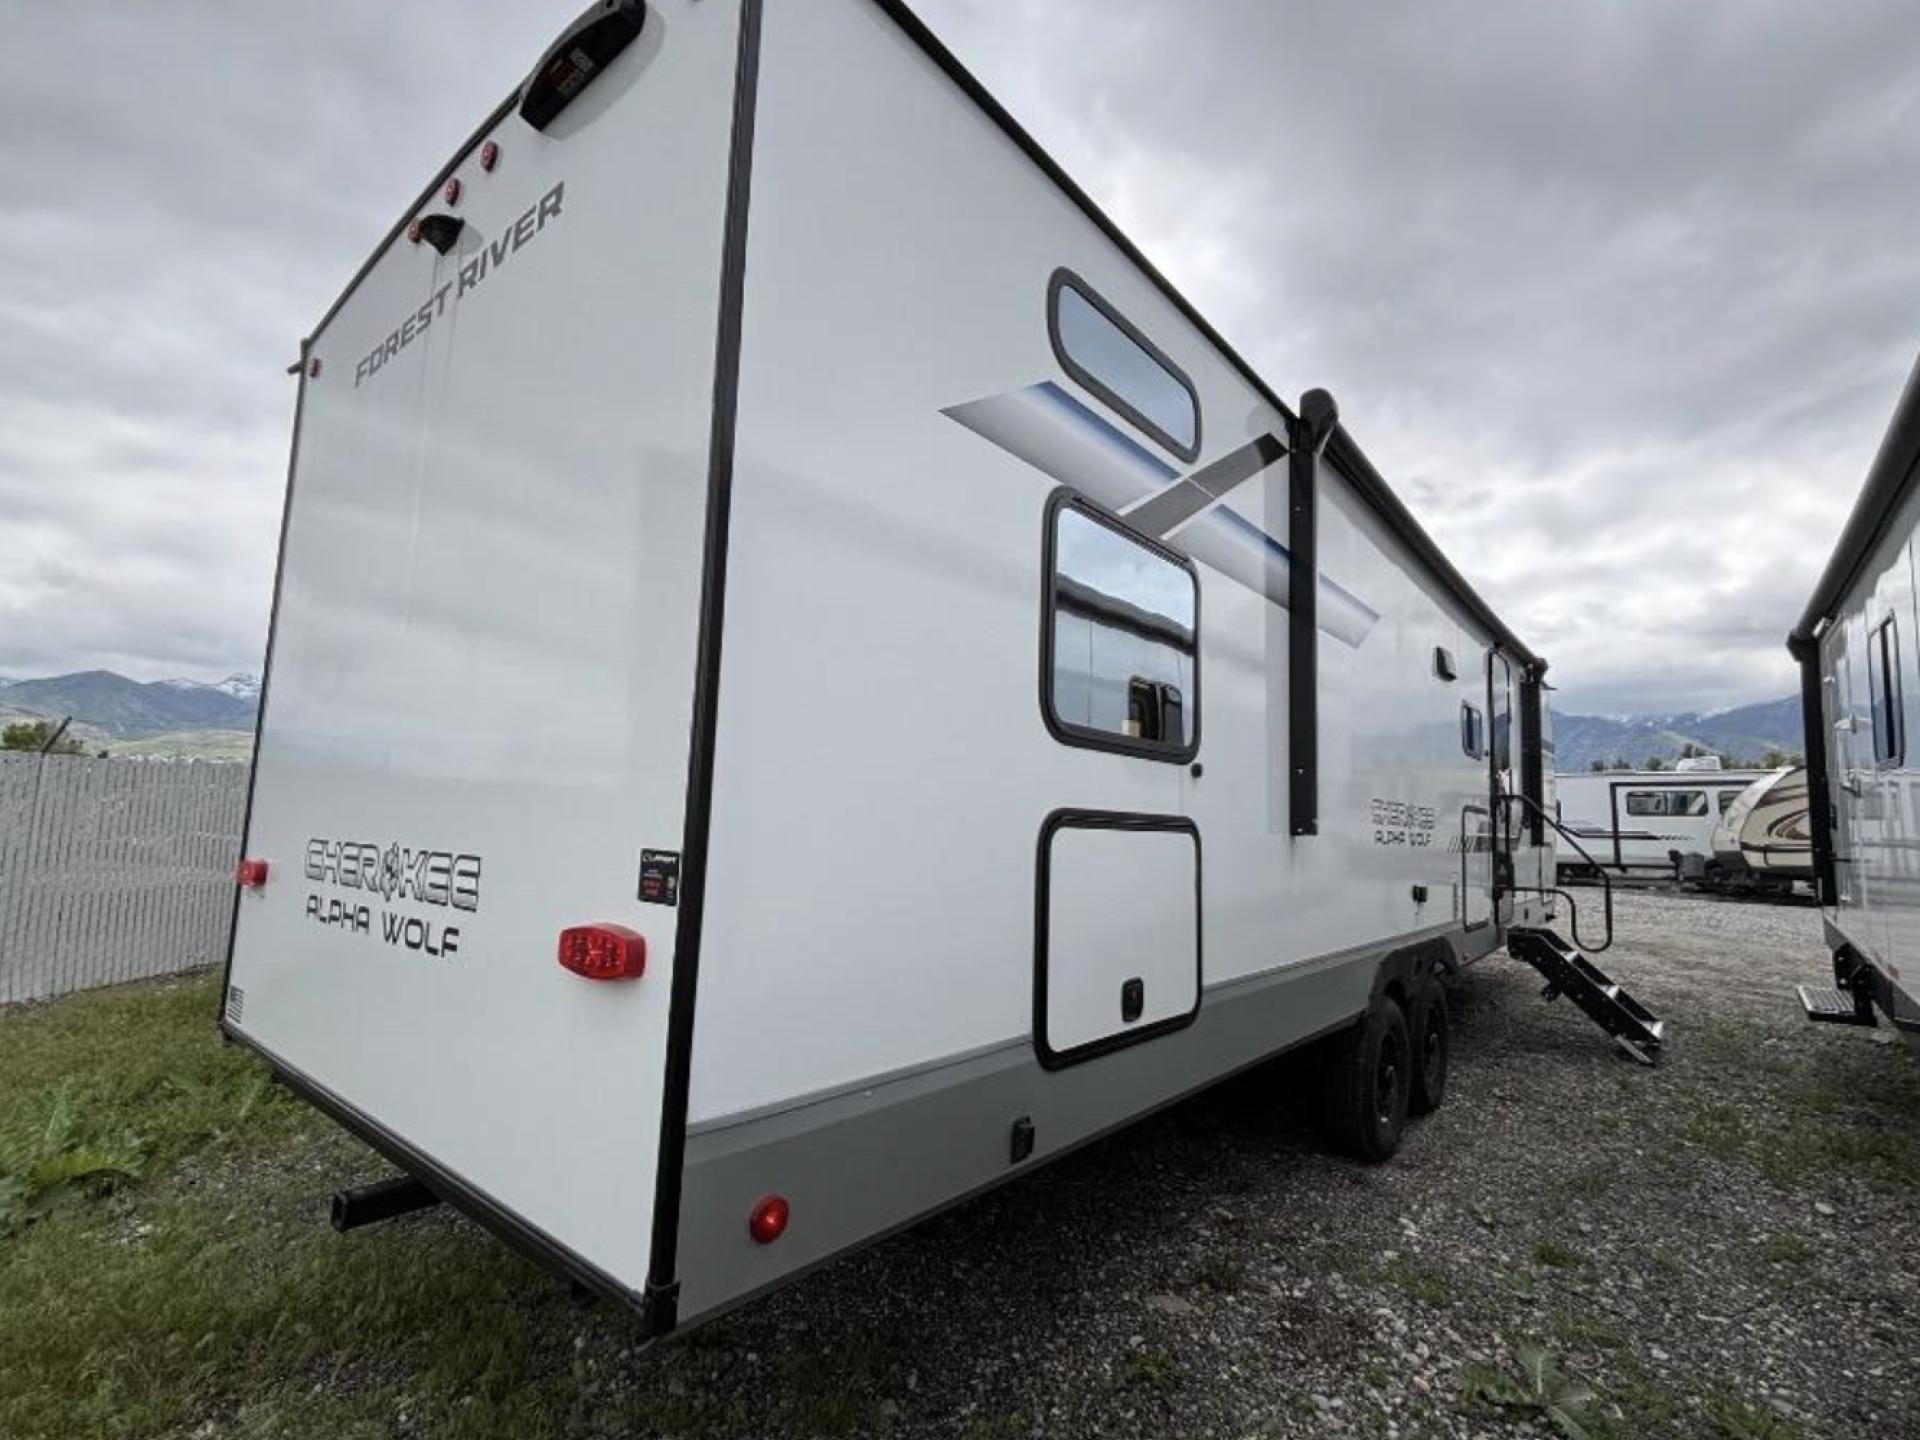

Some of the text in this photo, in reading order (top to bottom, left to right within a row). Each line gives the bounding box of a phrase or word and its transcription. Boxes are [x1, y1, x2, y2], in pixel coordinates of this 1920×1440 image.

[355, 180, 565, 387] FOREST RIVER
[304, 838, 482, 913] CHEROKEE
[305, 894, 460, 958] ALPHA WOLF
